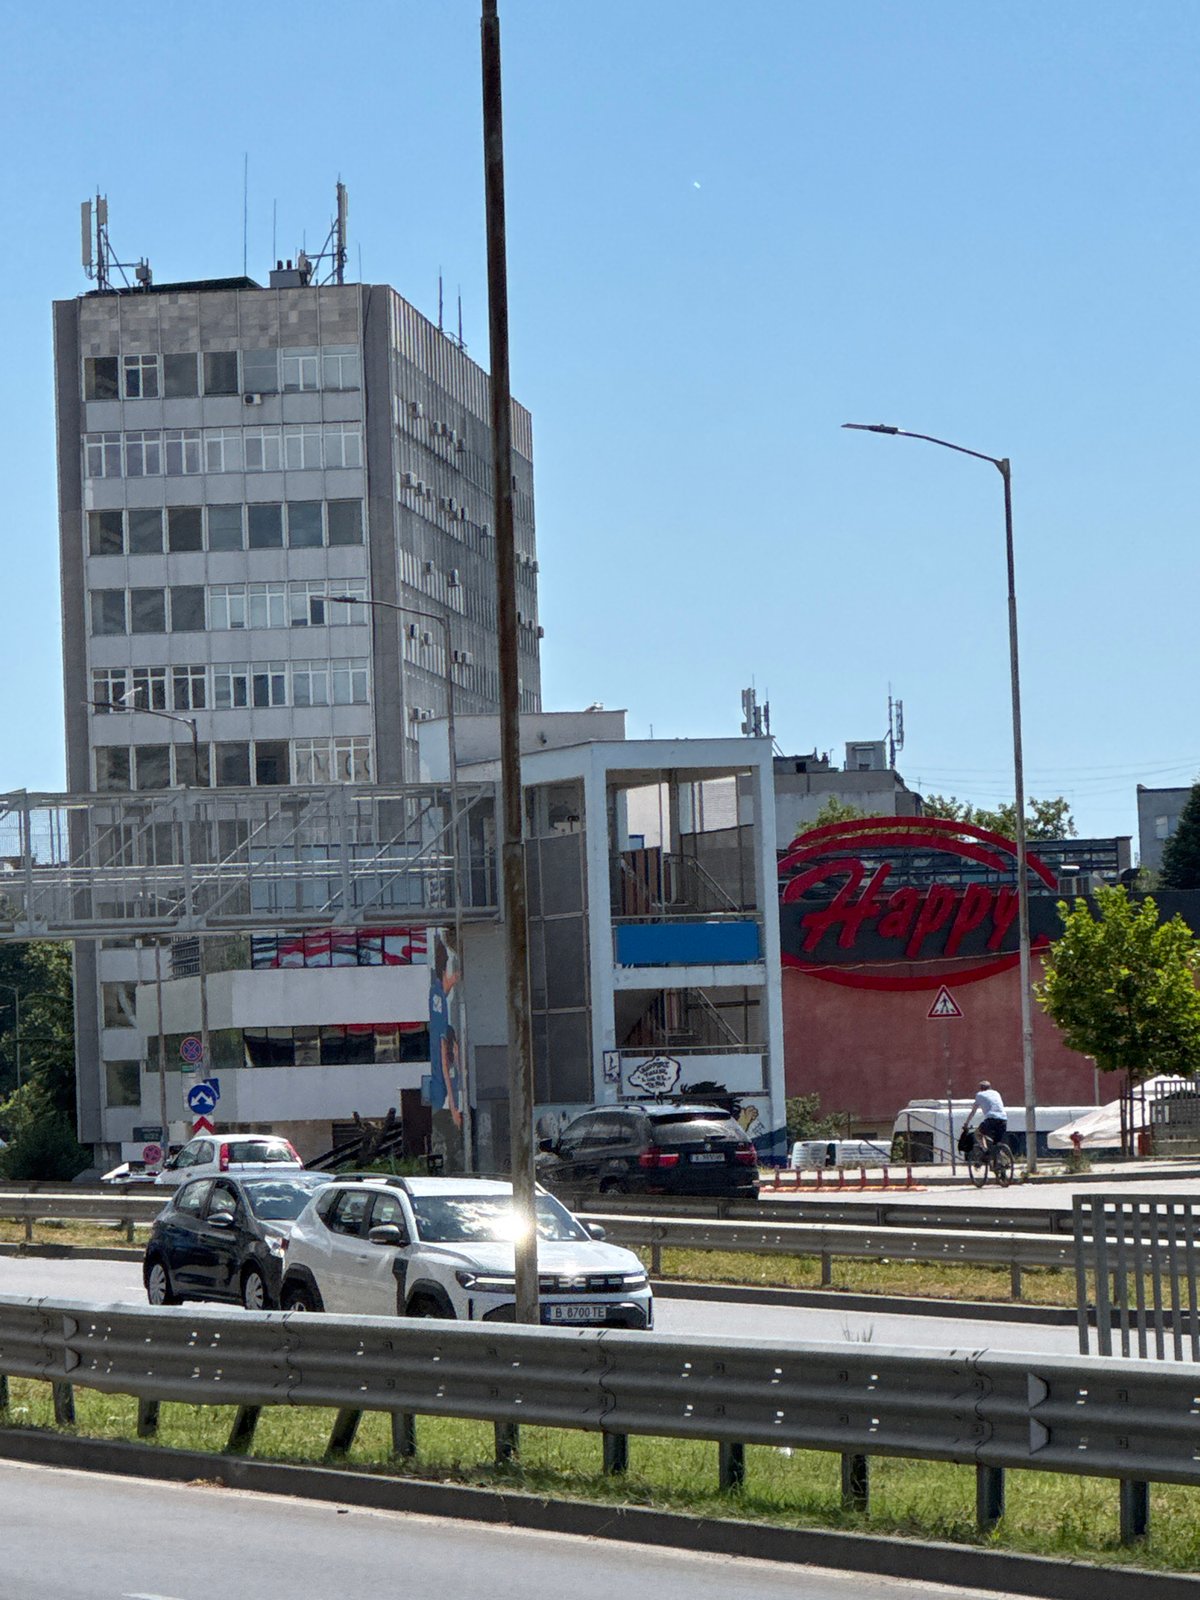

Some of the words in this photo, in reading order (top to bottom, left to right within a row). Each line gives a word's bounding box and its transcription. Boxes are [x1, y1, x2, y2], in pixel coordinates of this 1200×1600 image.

[783, 858, 1020, 959] Happy
[555, 1307, 562, 1318] B
[592, 1306, 605, 1317] TE
